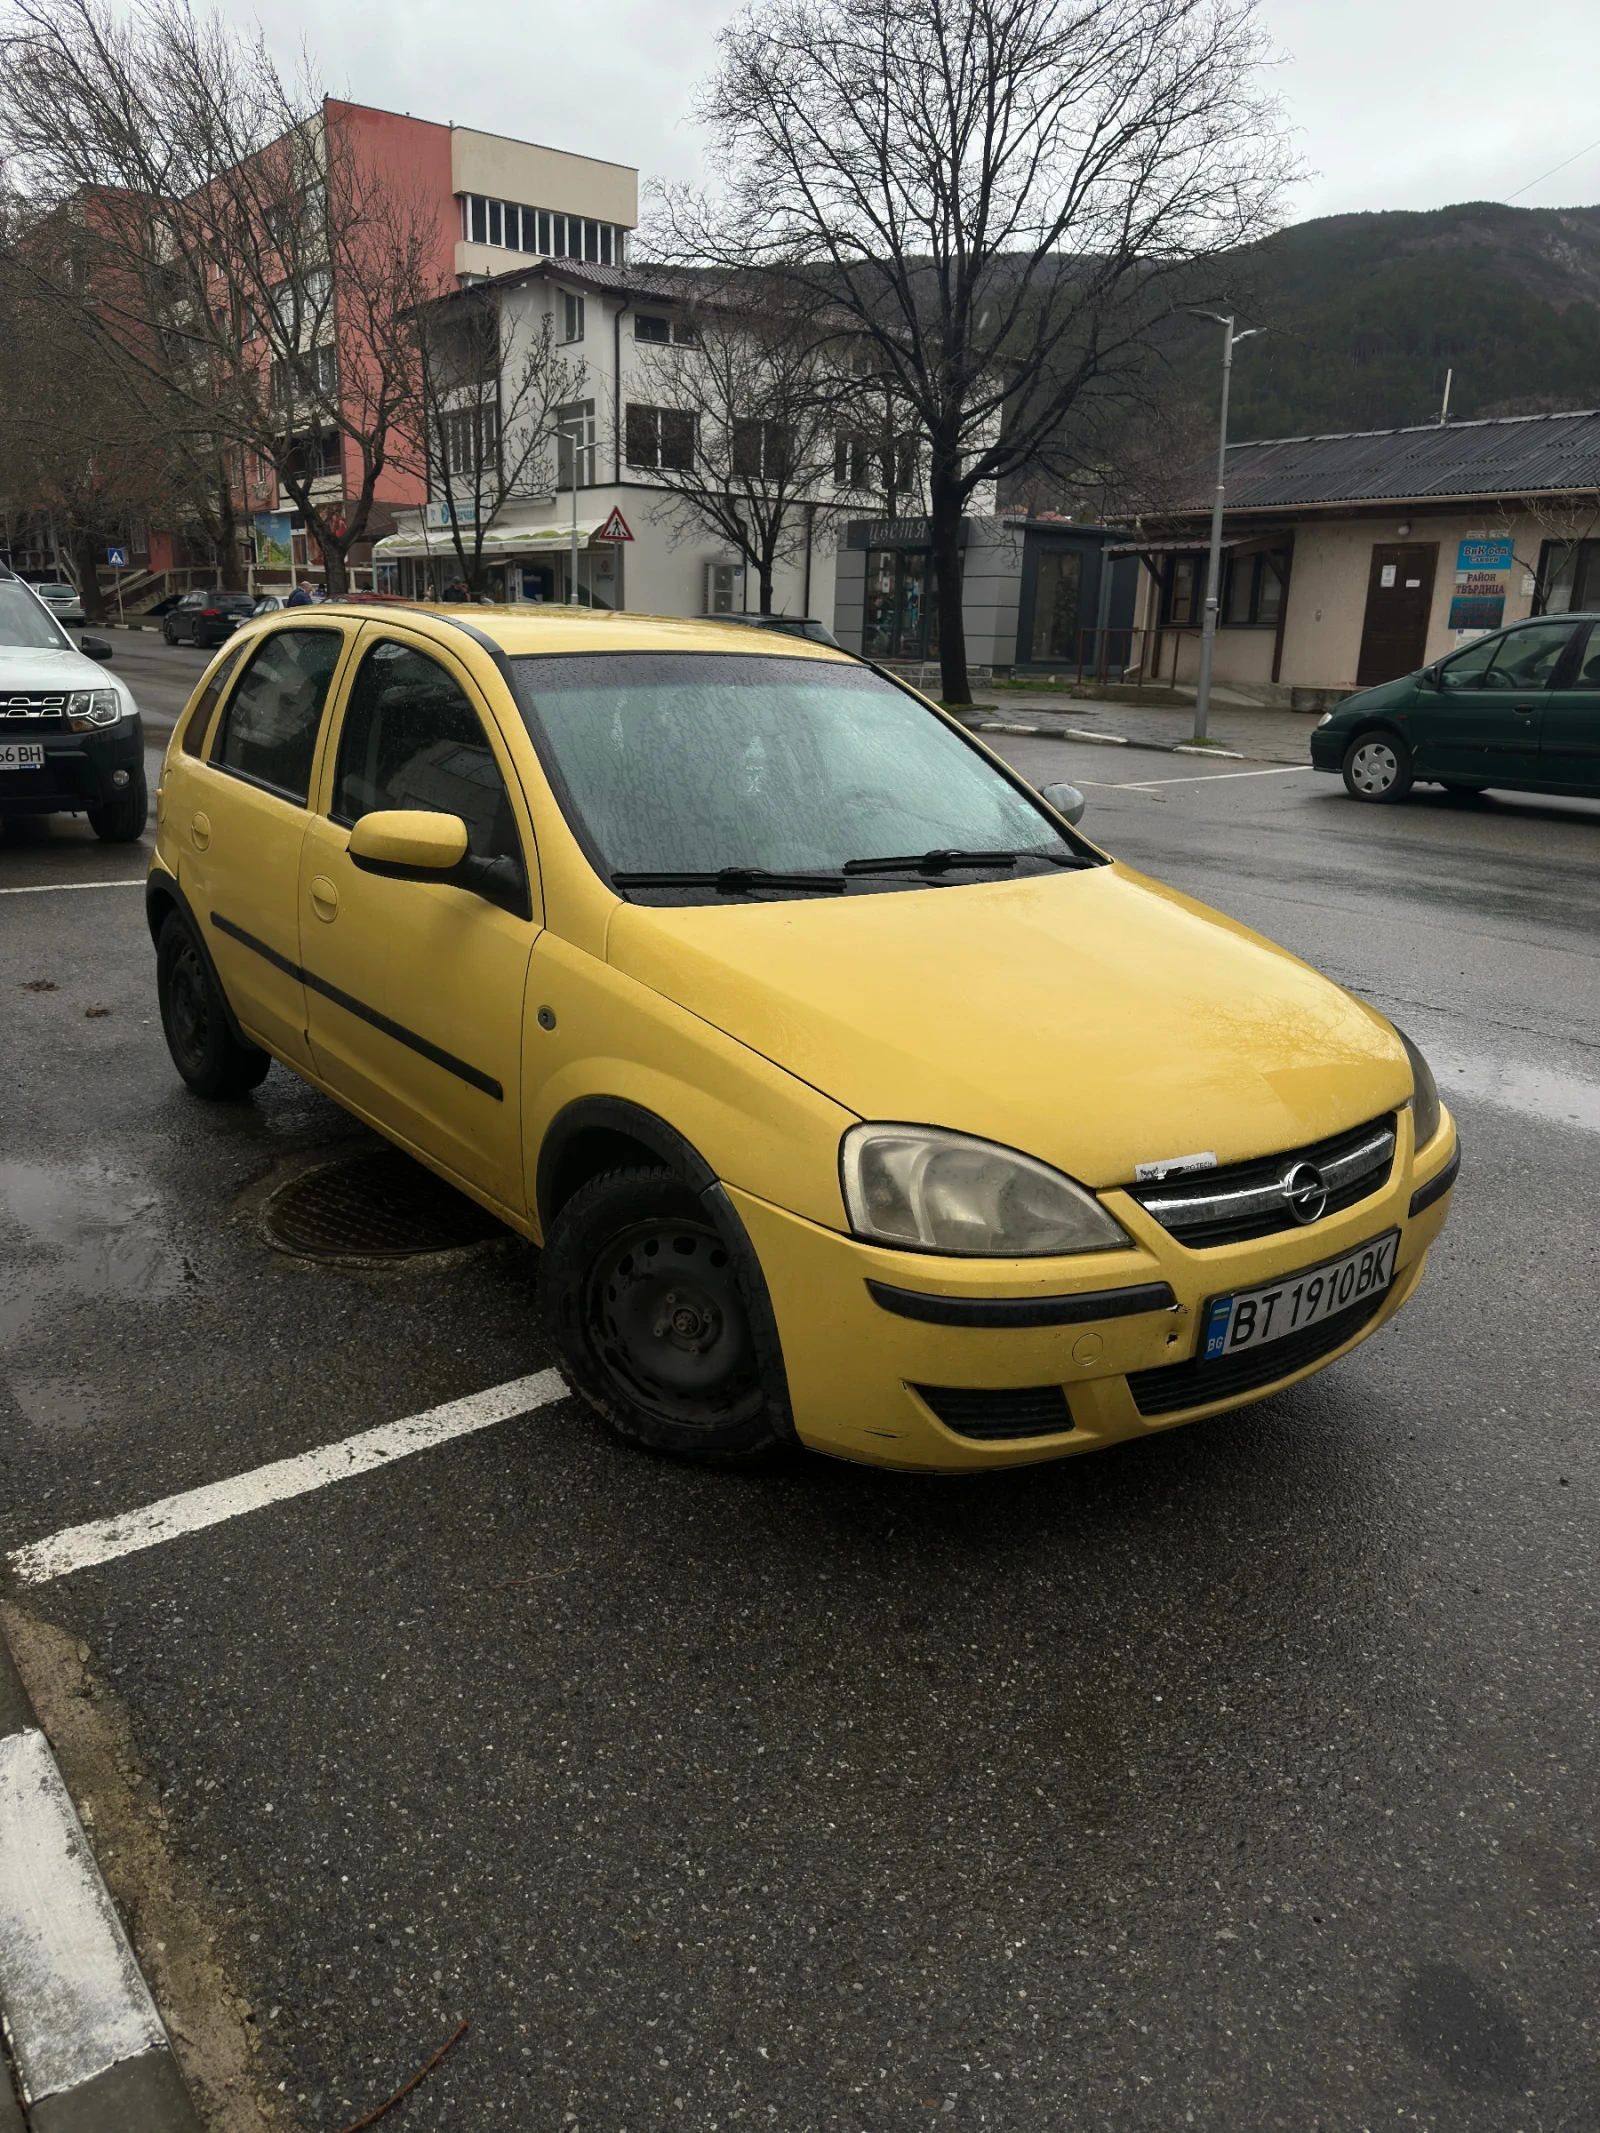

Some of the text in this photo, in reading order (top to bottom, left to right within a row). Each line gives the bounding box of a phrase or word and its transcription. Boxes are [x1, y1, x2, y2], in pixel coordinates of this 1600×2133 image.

[1467, 571, 1496, 582] РАЙОН
[1456, 584, 1505, 595] ТВЪРДИЦА
[18, 746, 41, 762] BH
[1229, 1290, 1283, 1347] BT
[1207, 1336, 1223, 1351] BG
